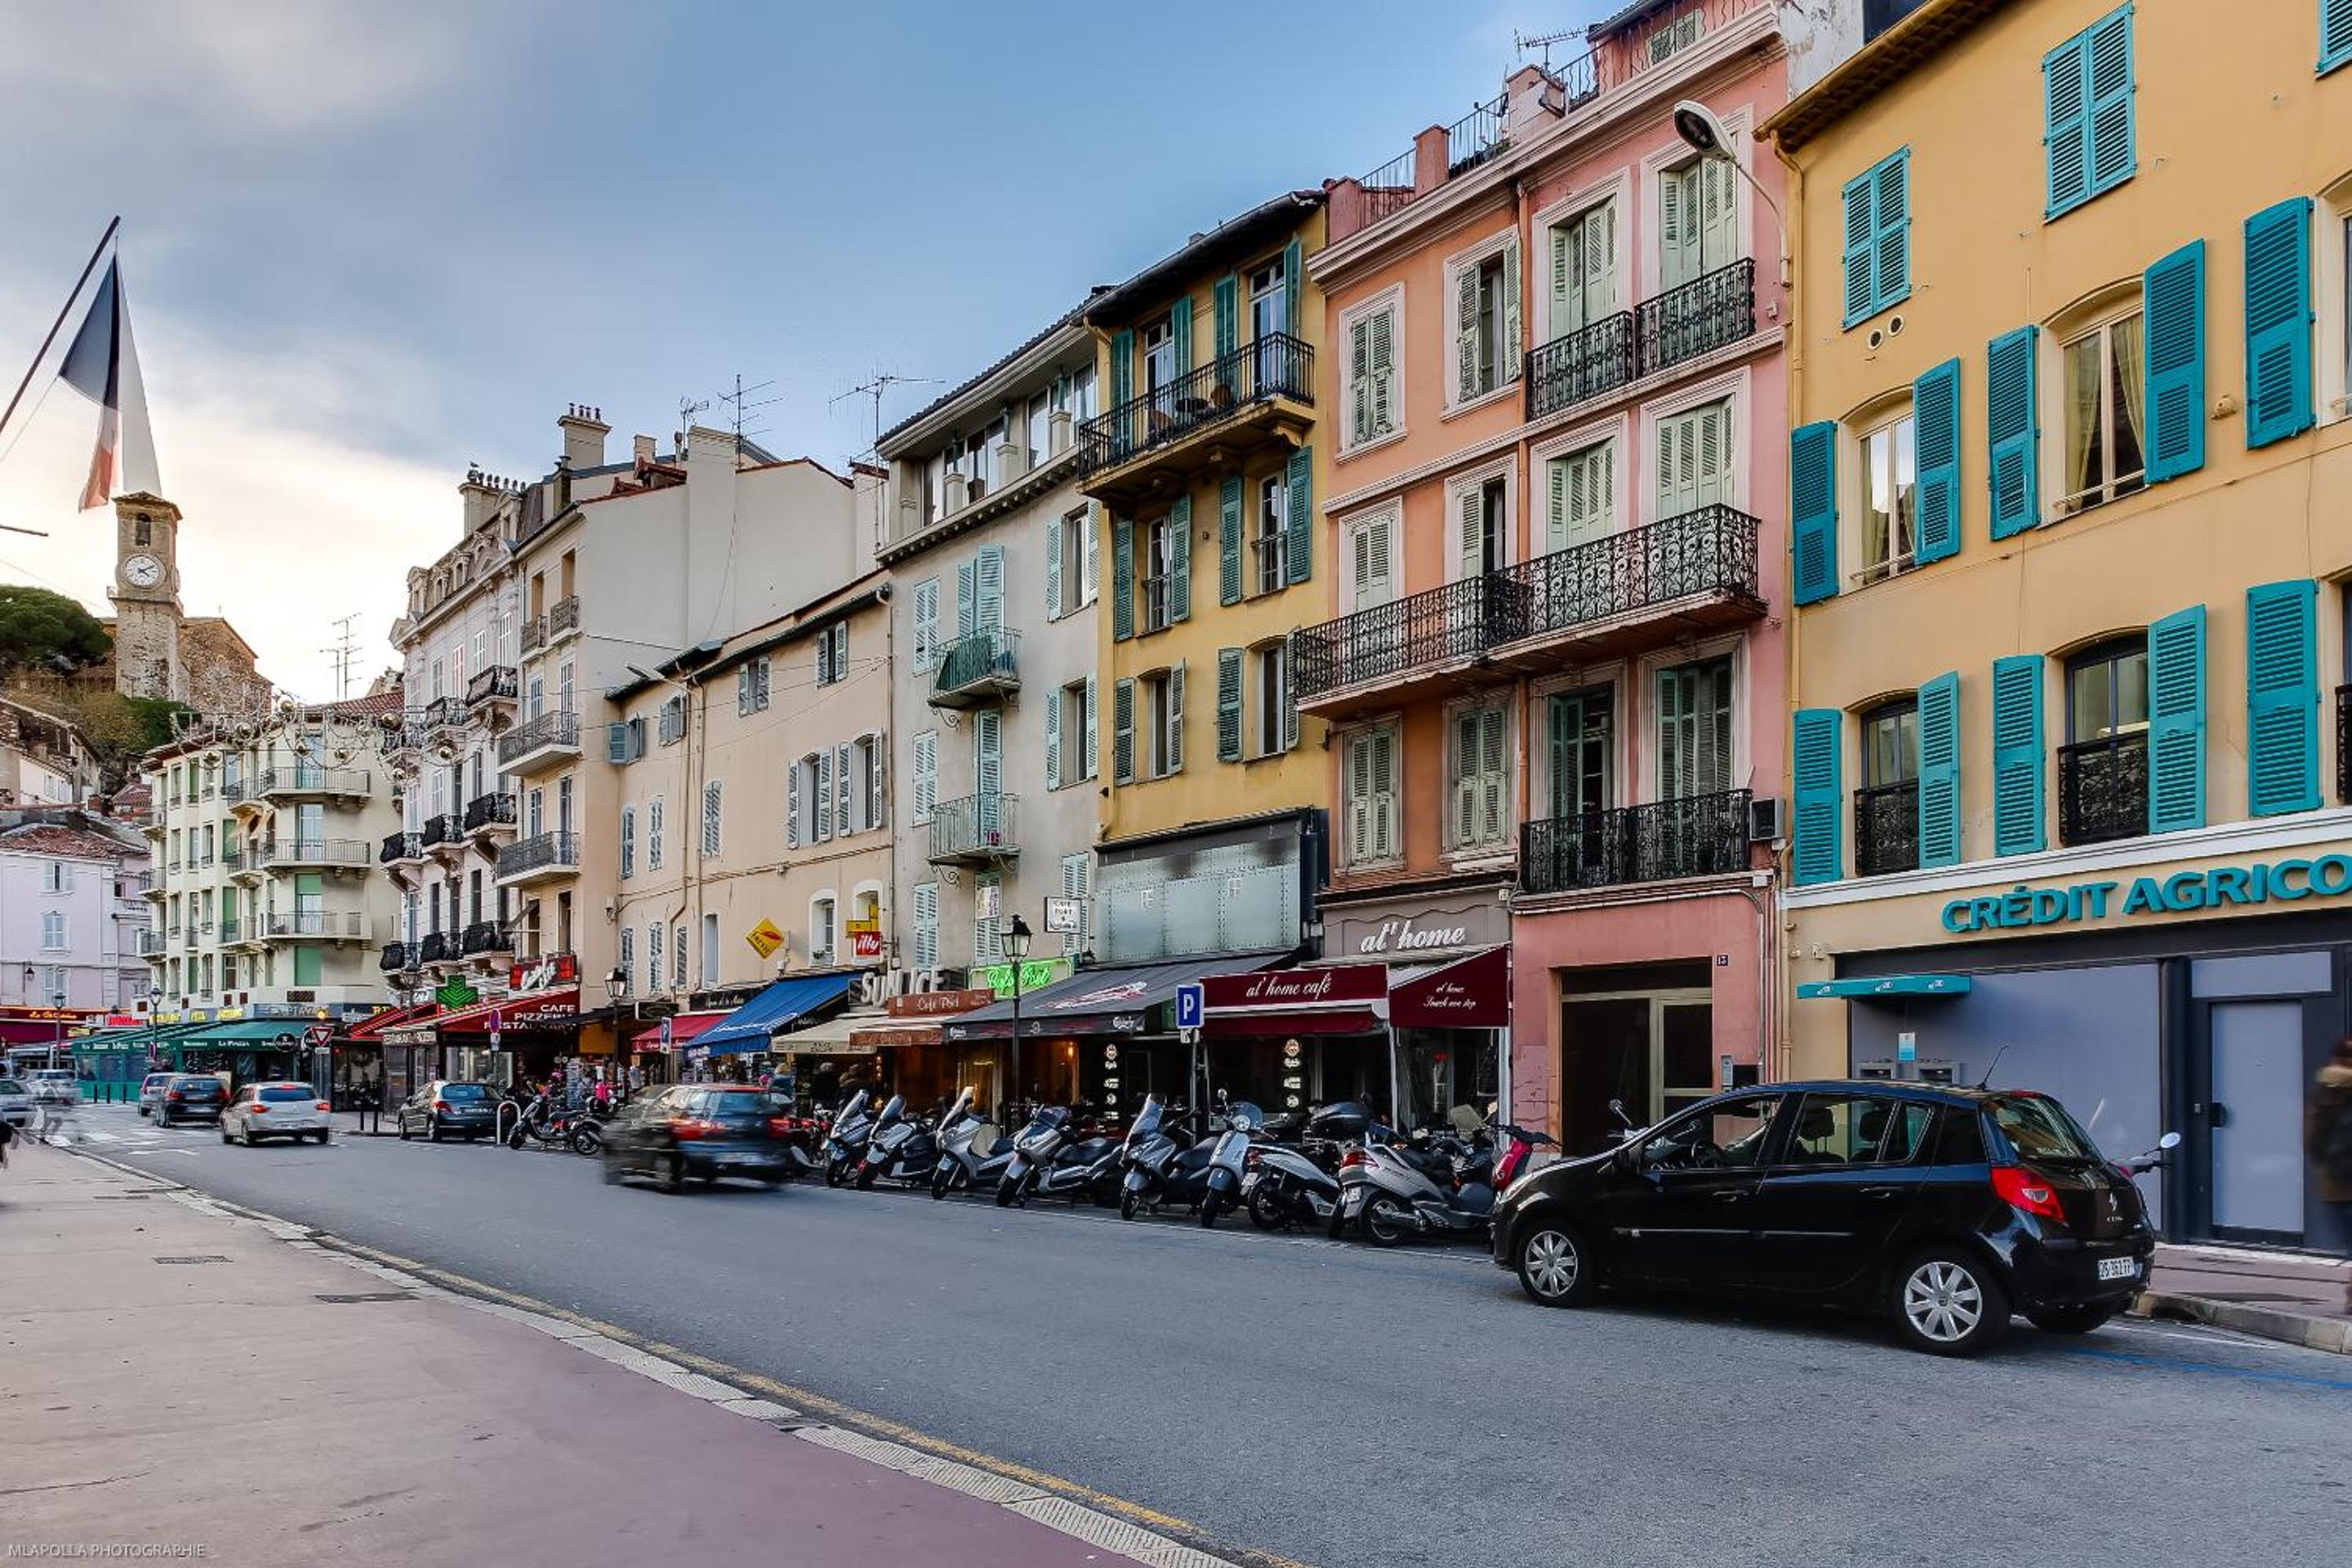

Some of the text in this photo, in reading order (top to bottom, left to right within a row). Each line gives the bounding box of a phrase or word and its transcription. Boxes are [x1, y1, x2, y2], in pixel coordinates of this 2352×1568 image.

[1941, 882, 2118, 933] CRÉDIT
[858, 934, 879, 953] illy
[1183, 994, 1194, 1020] P
